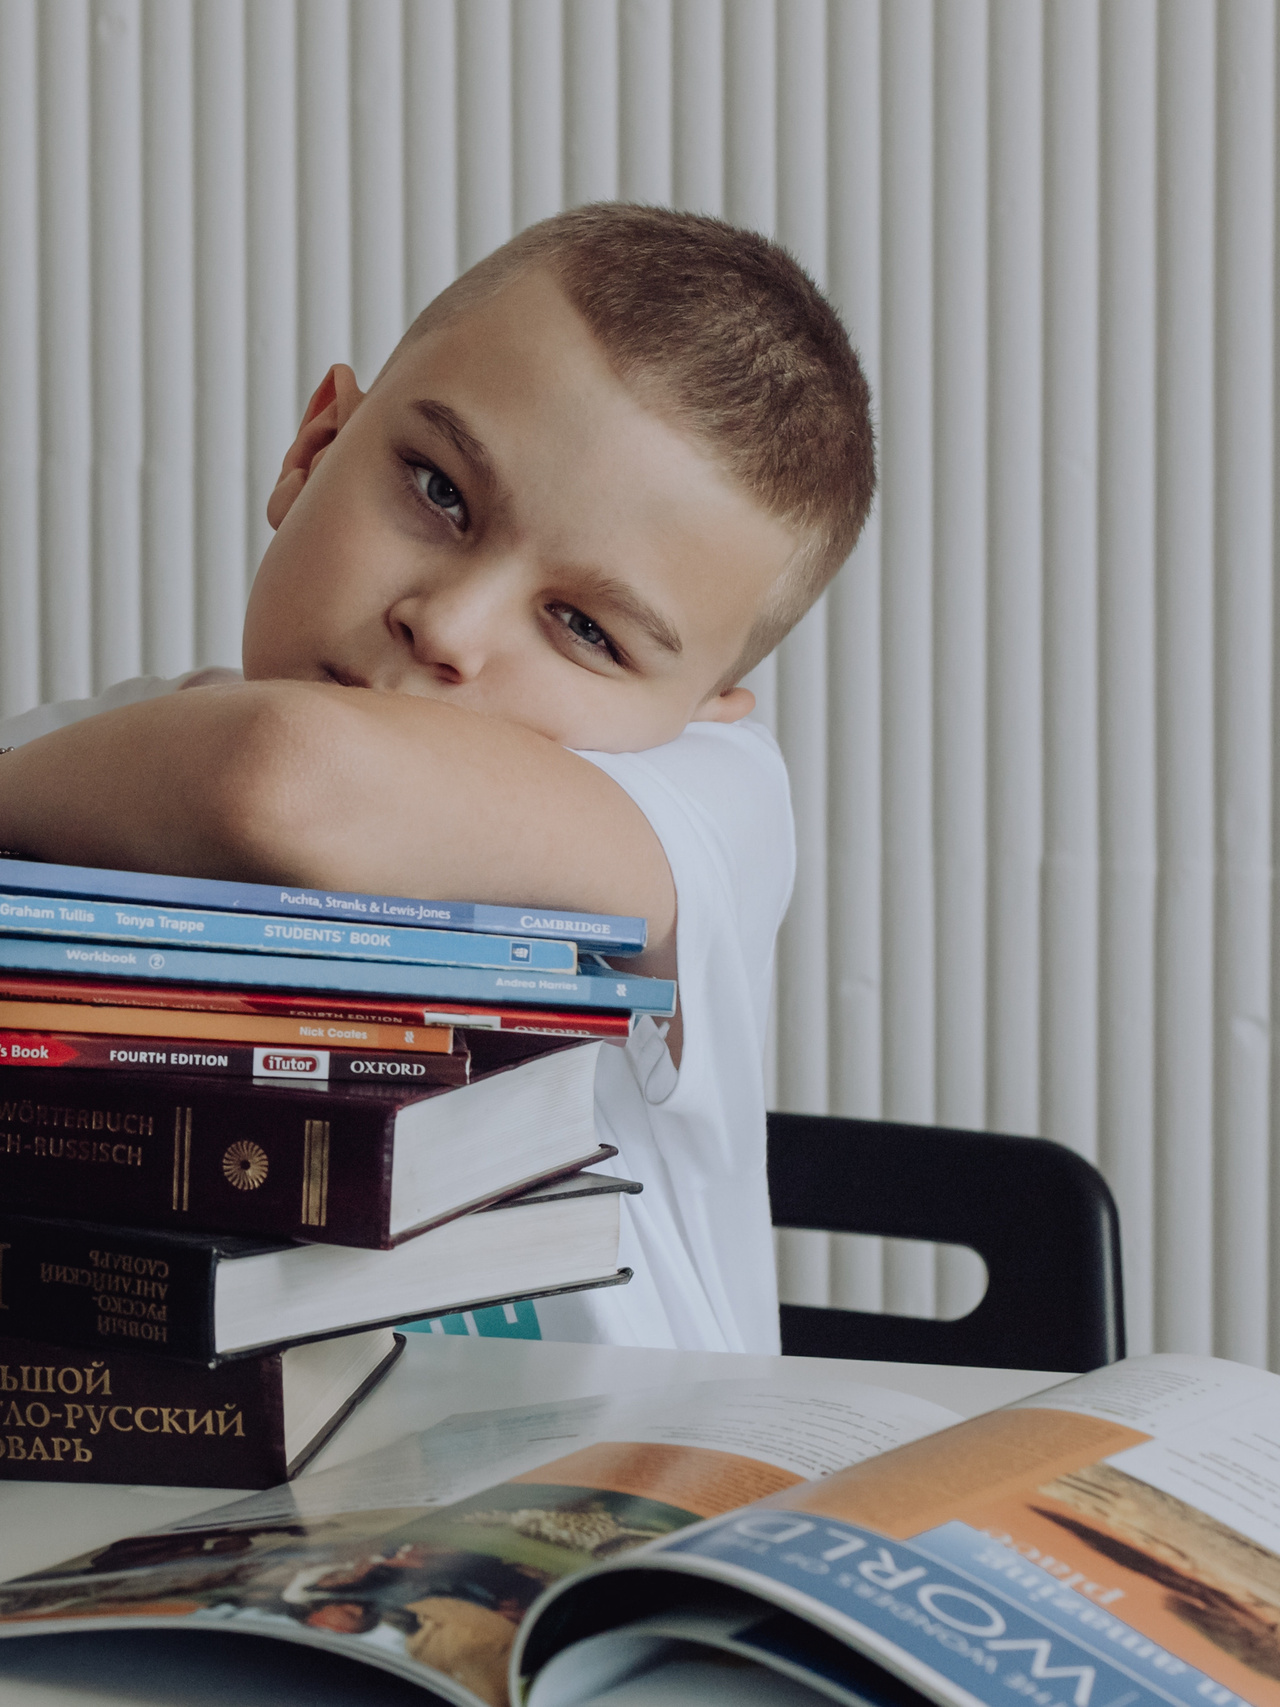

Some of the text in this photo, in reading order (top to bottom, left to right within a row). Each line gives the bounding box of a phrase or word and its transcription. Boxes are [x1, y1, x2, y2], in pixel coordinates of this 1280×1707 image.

[0, 903, 95, 923] Graham Tullis
[280, 892, 451, 920] Puchta, Stranks & Lewis-Jones
[115, 912, 205, 933] Tonya Trappe
[521, 915, 611, 935] CAMBRIDGE
[350, 932, 392, 948] BOOK
[66, 949, 137, 966] Workbook
[496, 977, 536, 991] Andrea
[299, 1026, 368, 1041] Nick Coates
[11, 1044, 49, 1060] Book
[110, 1049, 228, 1067] FOURTH EDITION
[268, 1056, 313, 1072] iTutor
[350, 1060, 426, 1077] OXFORD
[734, 1511, 1097, 1707] WORLD
